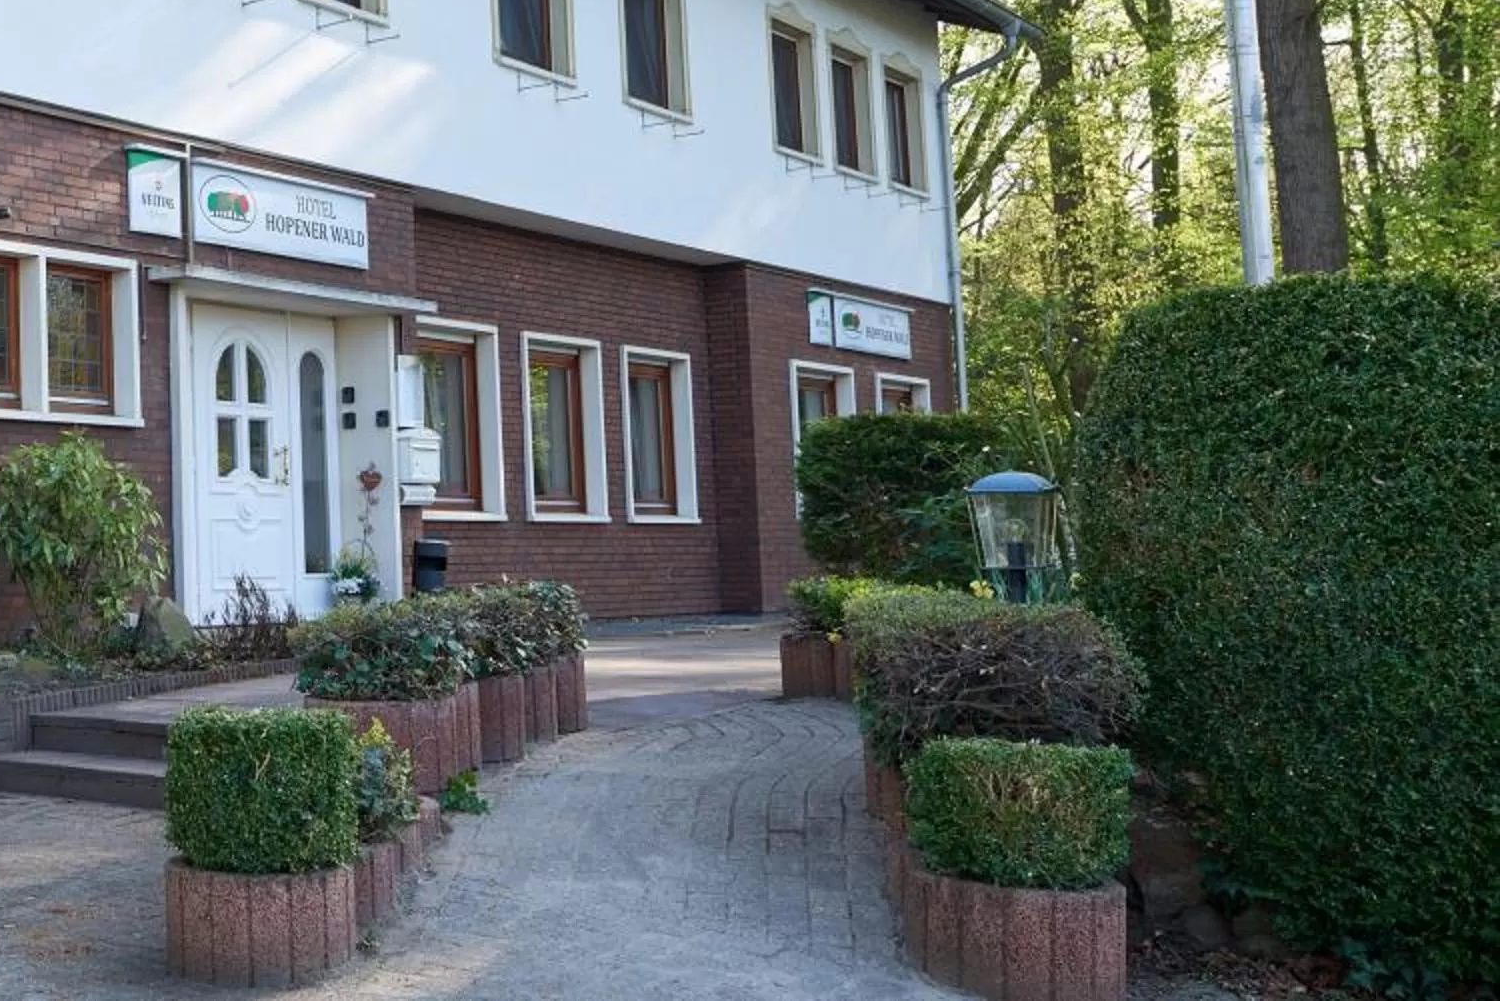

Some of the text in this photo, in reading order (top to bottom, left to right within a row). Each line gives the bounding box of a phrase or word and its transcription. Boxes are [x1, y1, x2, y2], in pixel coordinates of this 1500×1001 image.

[296, 194, 336, 220] HOTEL
[265, 212, 365, 248] HOPENER WALD
